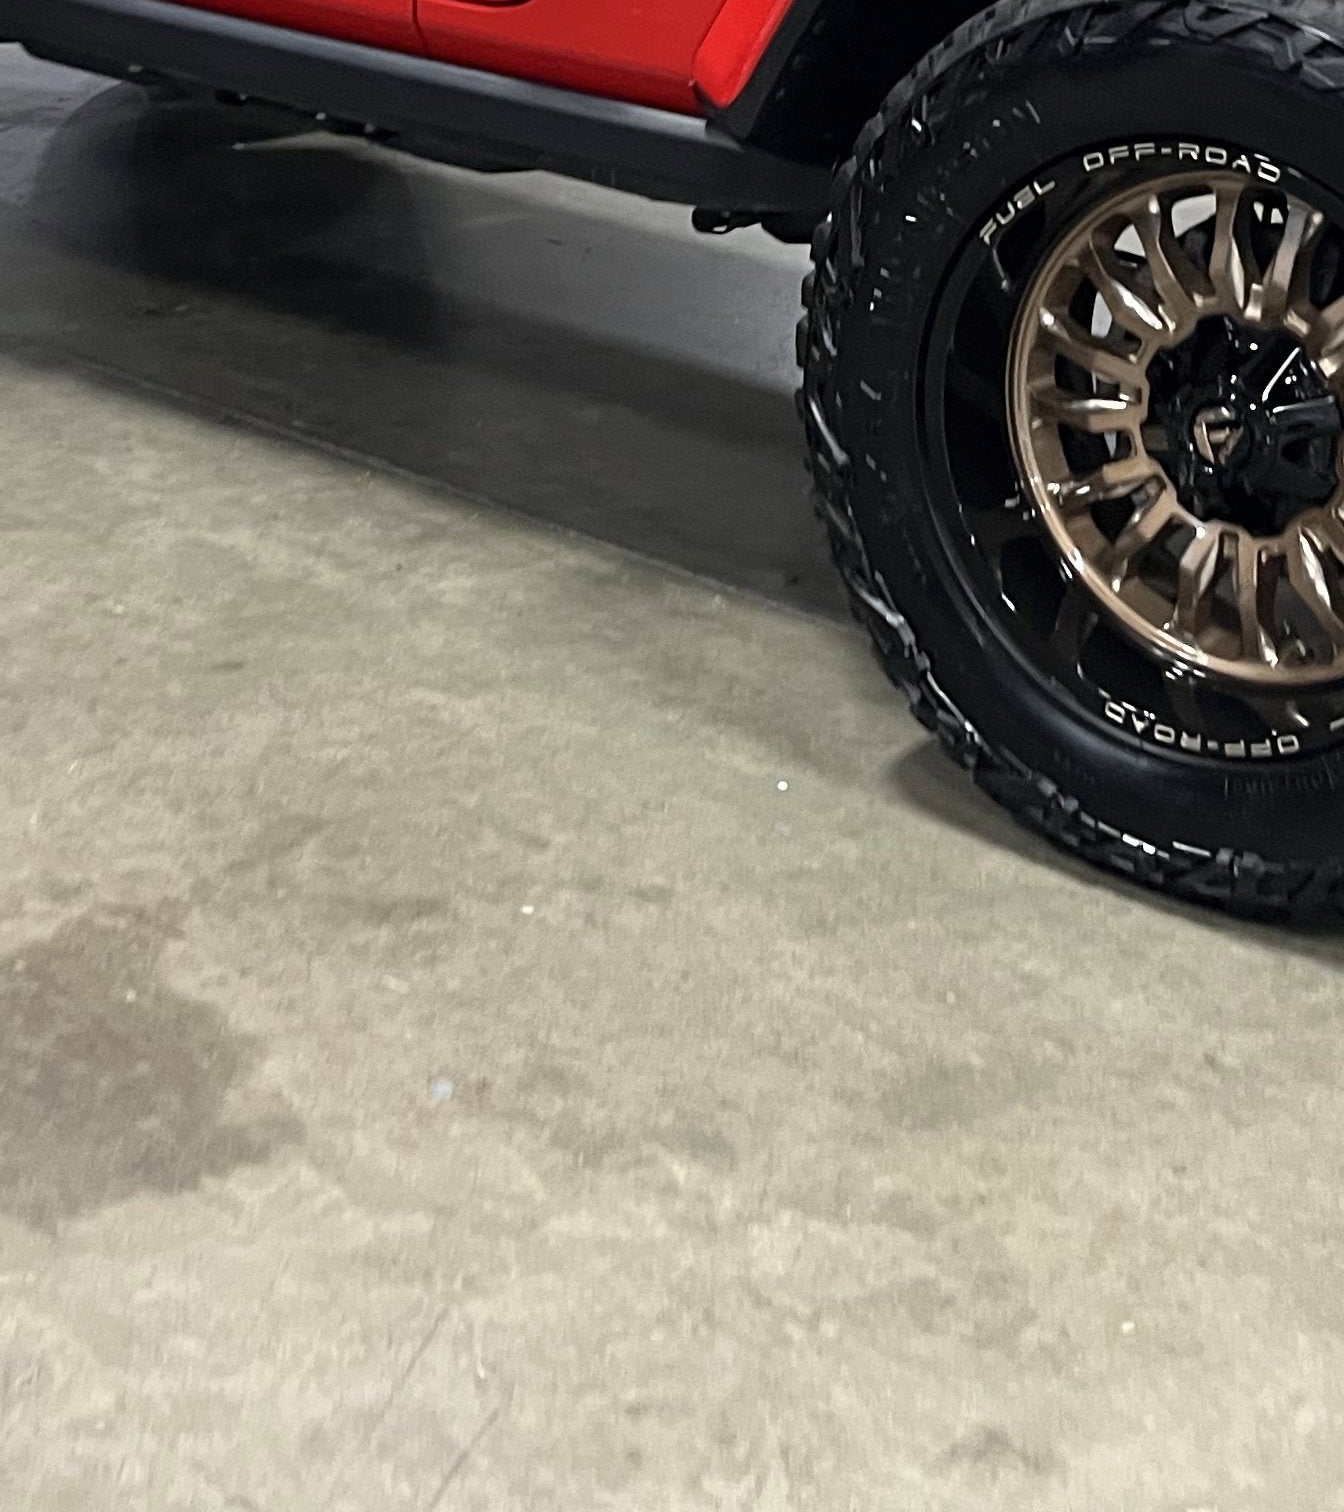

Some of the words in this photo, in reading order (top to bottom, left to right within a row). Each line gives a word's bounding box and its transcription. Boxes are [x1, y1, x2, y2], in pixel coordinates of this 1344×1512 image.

[979, 180, 1056, 246] FUEL
[1083, 142, 1281, 183] OFF-ROAD
[1104, 700, 1301, 758] OFF-ROAD
